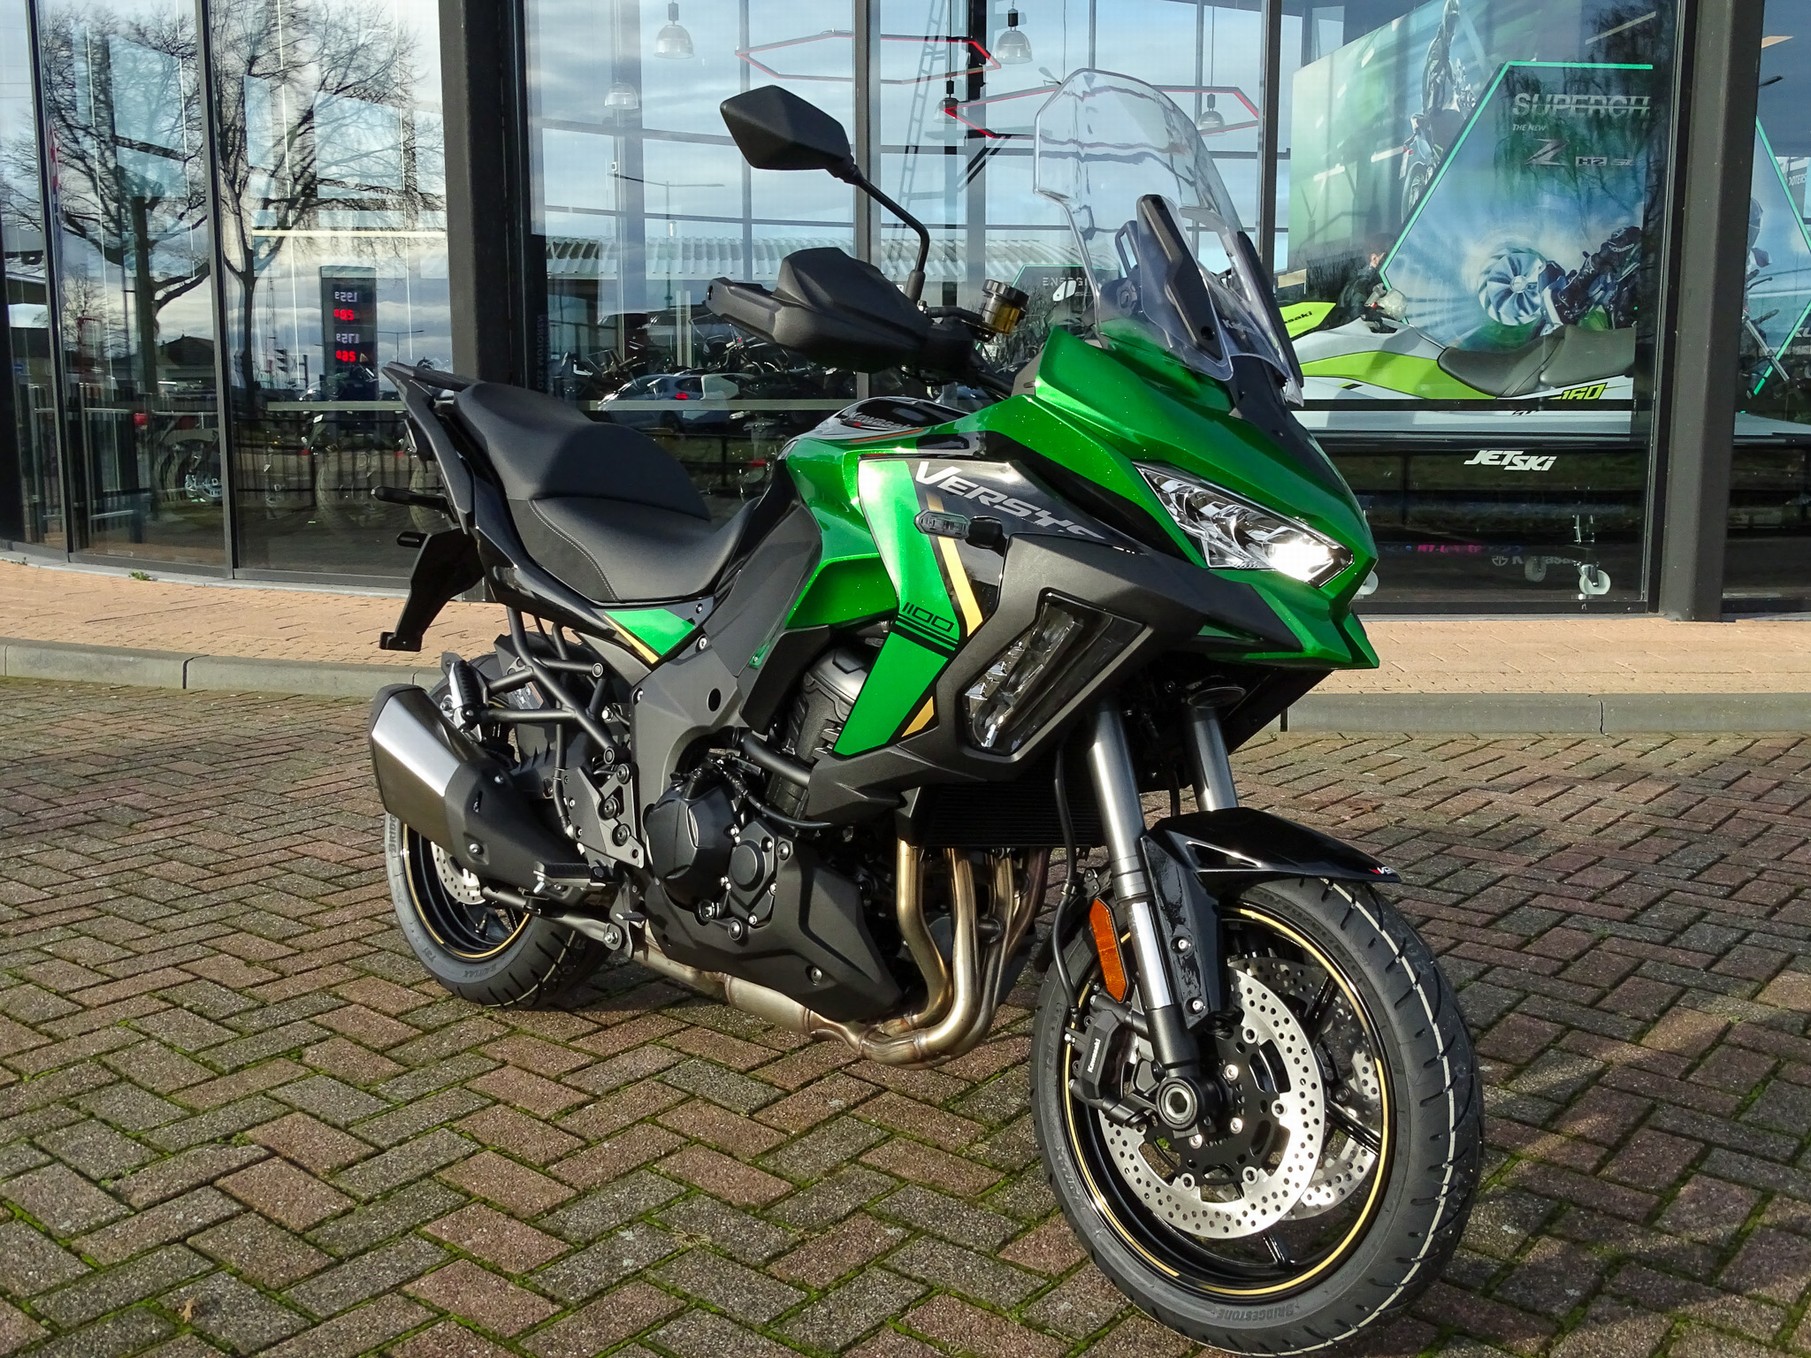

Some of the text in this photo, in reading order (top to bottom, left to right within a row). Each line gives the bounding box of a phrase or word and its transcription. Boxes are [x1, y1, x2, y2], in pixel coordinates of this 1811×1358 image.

[1512, 123, 1527, 132] THE
[902, 602, 954, 632] 1100
[1217, 1303, 1294, 1321] BRIDGESTONE
